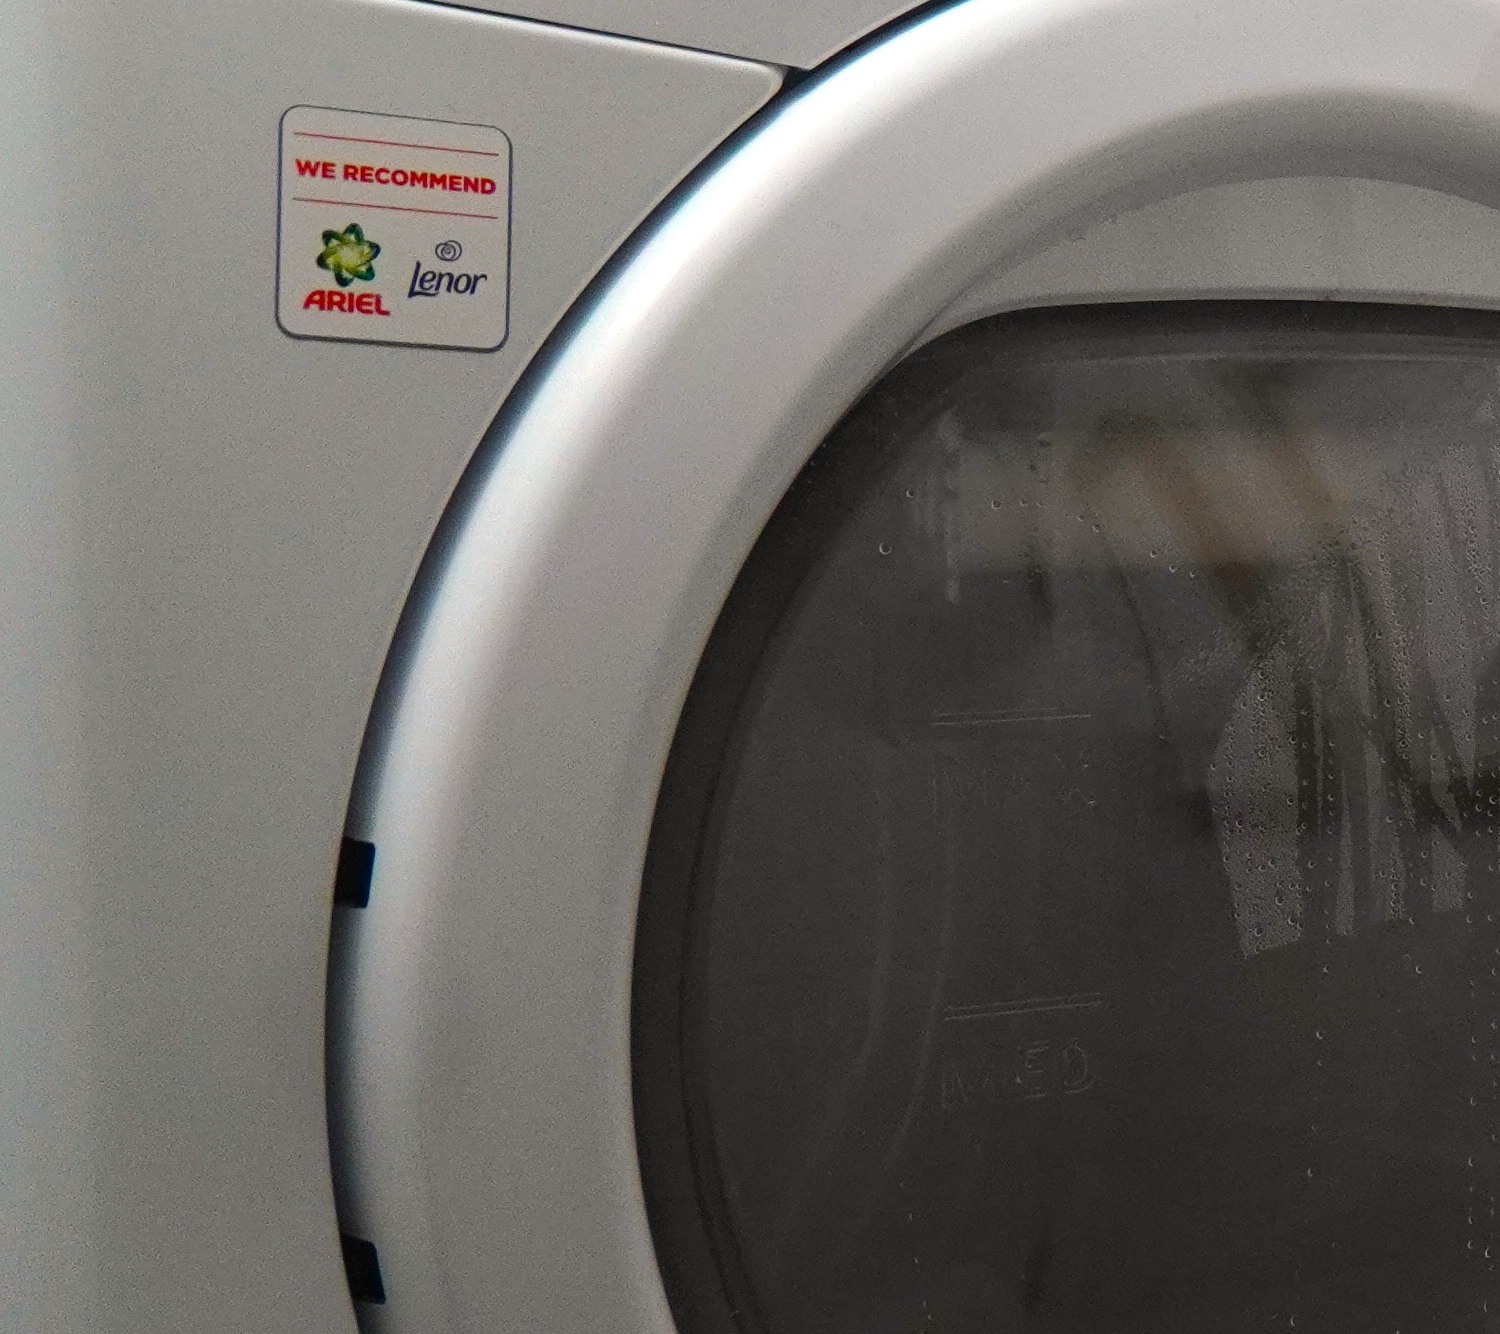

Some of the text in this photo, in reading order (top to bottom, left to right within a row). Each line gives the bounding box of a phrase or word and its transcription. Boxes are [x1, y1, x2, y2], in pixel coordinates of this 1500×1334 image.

[295, 158, 496, 195] WE RECOMMEND
[407, 260, 488, 298] Lenor
[303, 289, 391, 316] ARIEL
